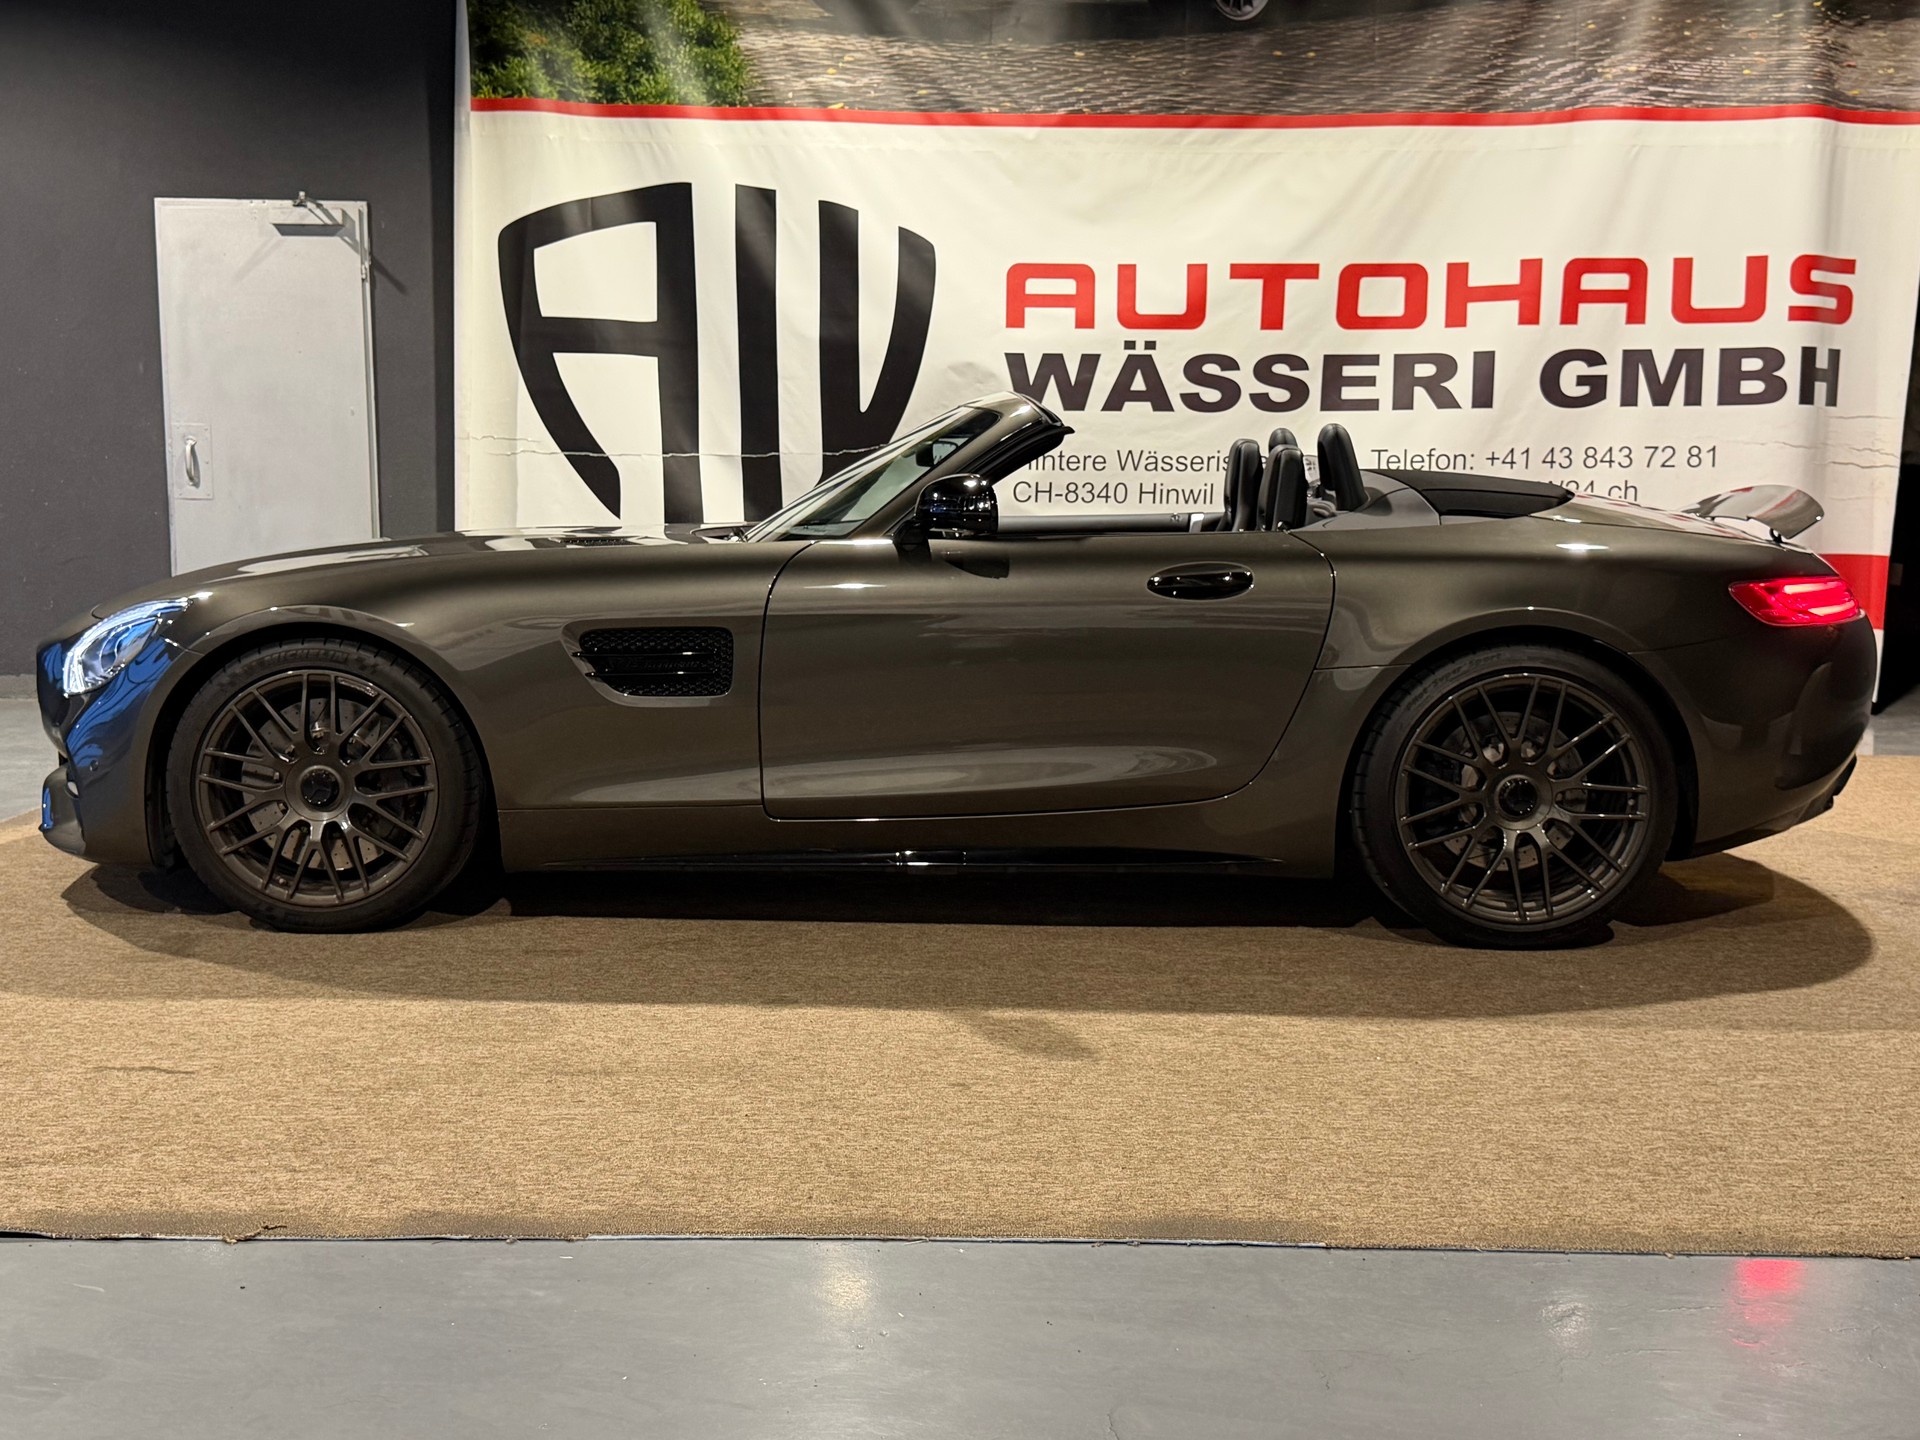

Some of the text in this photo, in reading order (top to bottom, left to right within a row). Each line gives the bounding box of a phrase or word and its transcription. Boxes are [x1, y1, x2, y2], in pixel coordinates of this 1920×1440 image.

[1005, 254, 1857, 331] AUTOHAUS
[1004, 340, 1842, 412] WÄSSERI GMBH
[1028, 450, 1107, 472] intere
[1371, 445, 1718, 470] Telefon: +41 43 843 72 81
[1013, 481, 1215, 505] CH-8340 Hinwil
